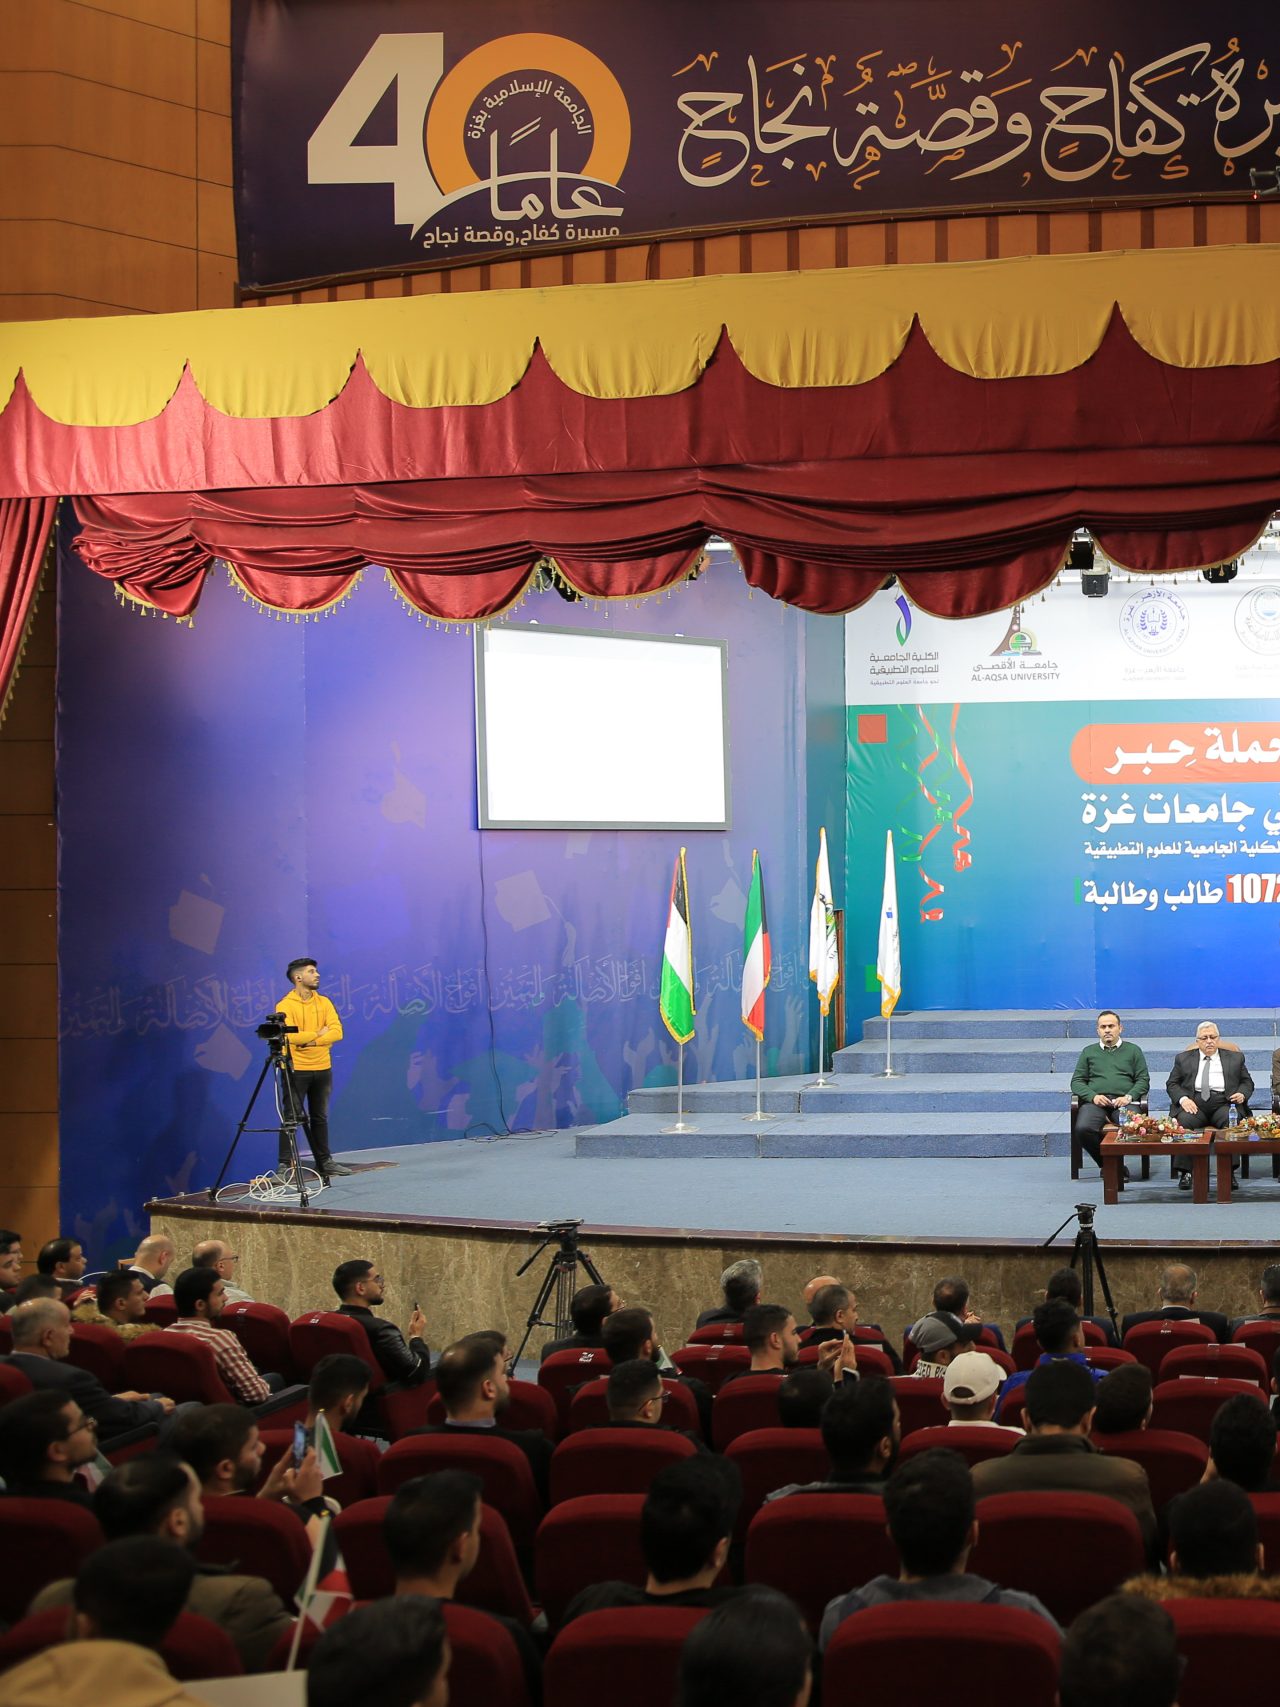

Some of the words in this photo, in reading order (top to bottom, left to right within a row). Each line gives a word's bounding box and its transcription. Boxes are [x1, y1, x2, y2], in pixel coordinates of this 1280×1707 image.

[482, 79, 553, 110] الإسلامية
[553, 86, 592, 135] الجامعة
[676, 54, 830, 188] نجاح
[1041, 43, 1213, 183] كفاح
[467, 110, 492, 139] بغزة
[422, 227, 459, 249] نجاح
[870, 652, 911, 663] الجامعية
[911, 651, 939, 662] الكلية
[972, 657, 1016, 672] الأقصى
[1019, 660, 1058, 671] جامعة
[971, 673, 1008, 682] AL-AQSA
[1010, 672, 1061, 681] UNIVERSITY
[1080, 791, 1137, 833] غزة
[1143, 791, 1256, 833] جامعات
[1084, 841, 1144, 859] التطبيقية
[1145, 841, 1182, 859] للعلوم
[1184, 840, 1238, 859] الجامعية
[1083, 879, 1159, 912] وطالبة
[1163, 879, 1224, 912] طالب
